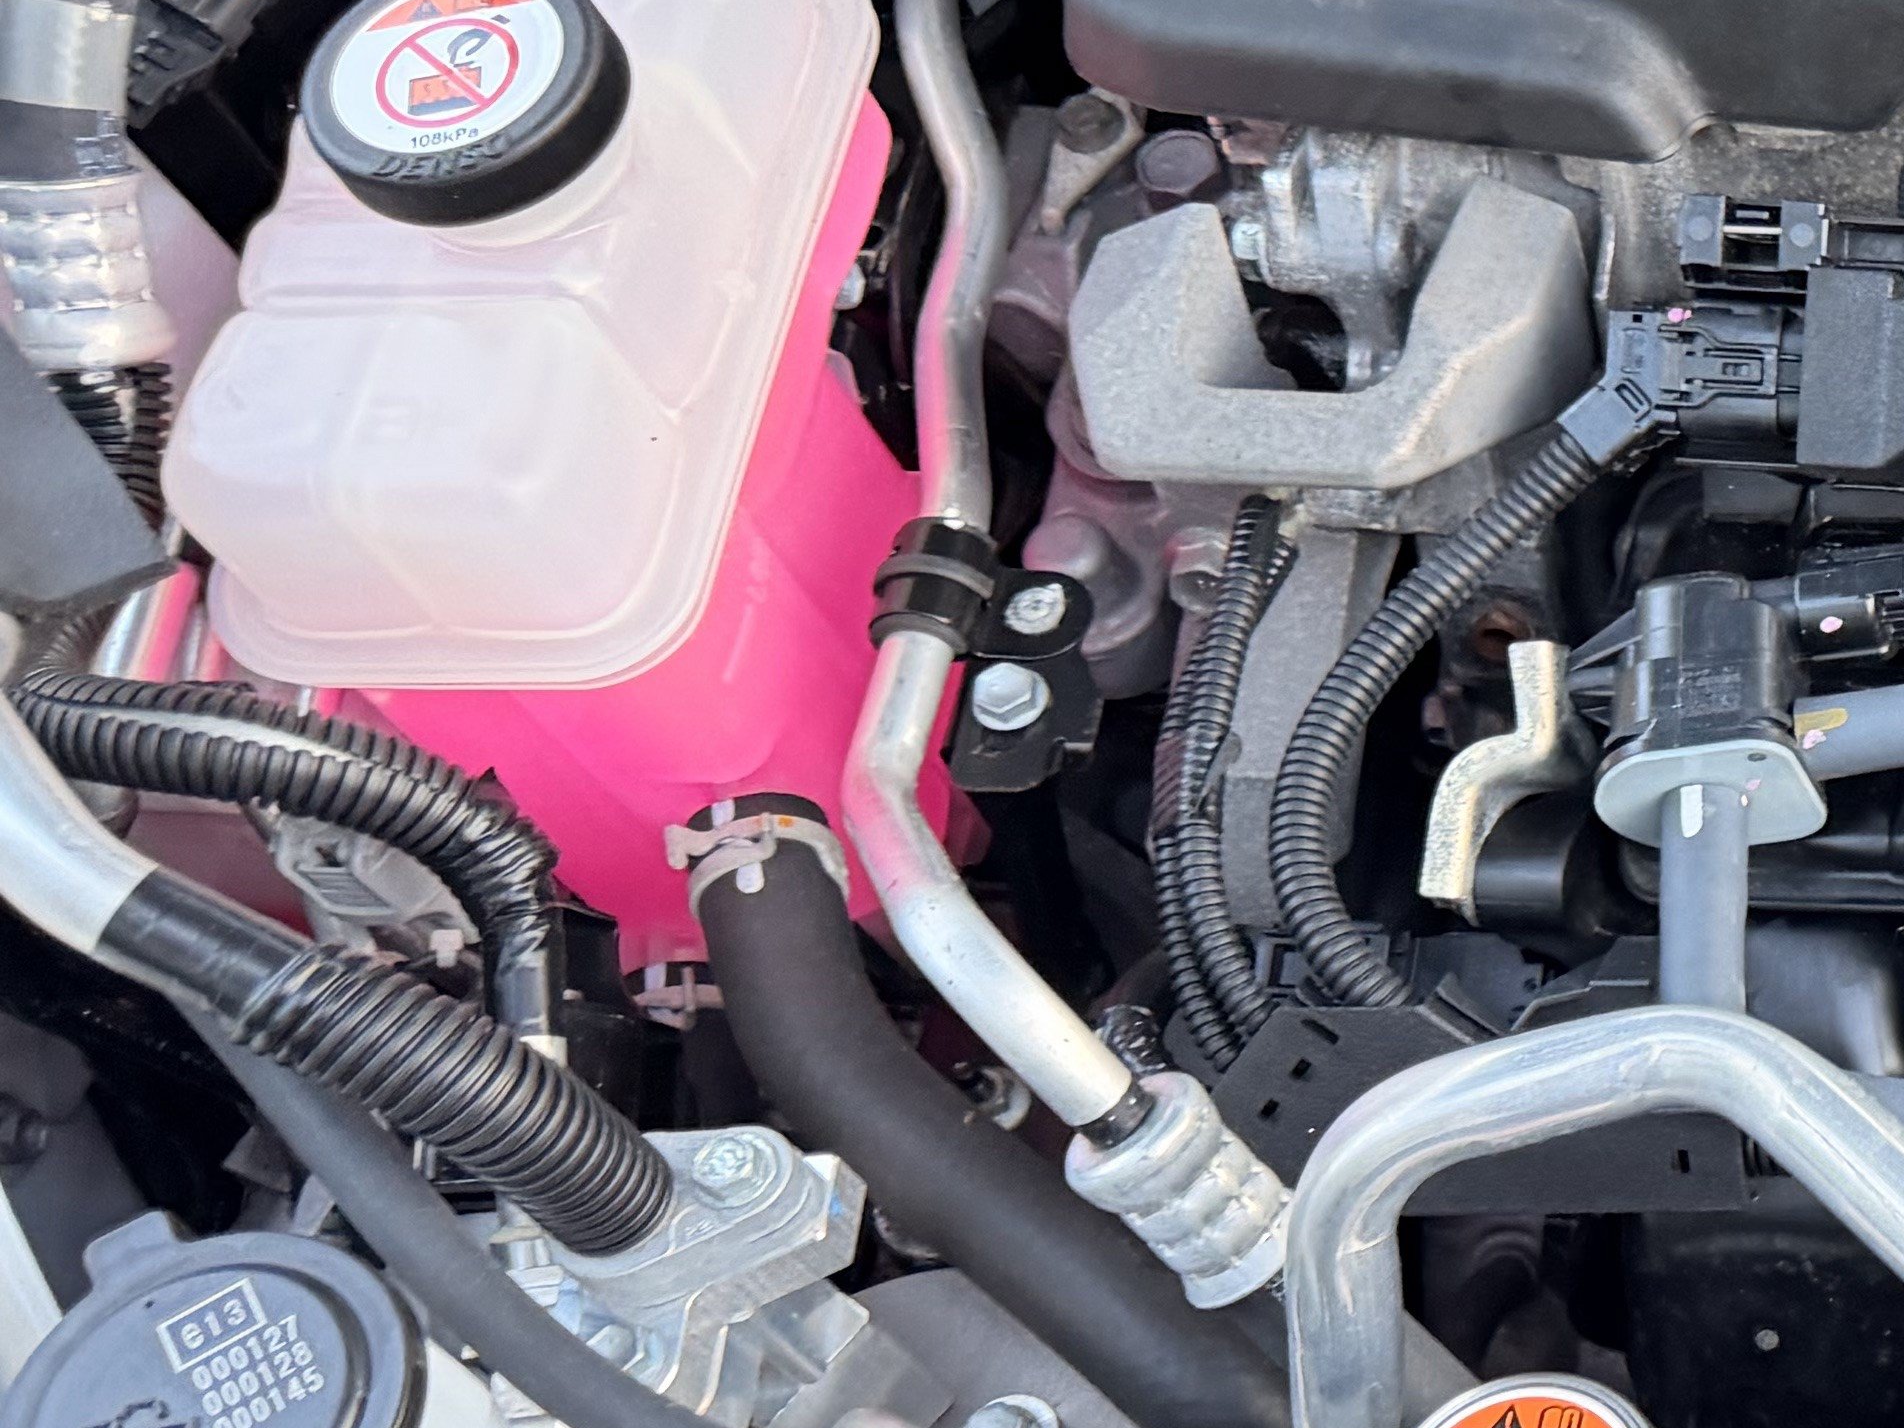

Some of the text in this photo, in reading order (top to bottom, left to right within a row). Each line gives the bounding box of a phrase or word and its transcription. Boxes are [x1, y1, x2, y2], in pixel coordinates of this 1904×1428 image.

[411, 127, 479, 150] 108kPa
[180, 1298, 248, 1350] e13
[191, 1314, 298, 1391] 000127
[201, 1340, 314, 1417] 000128
